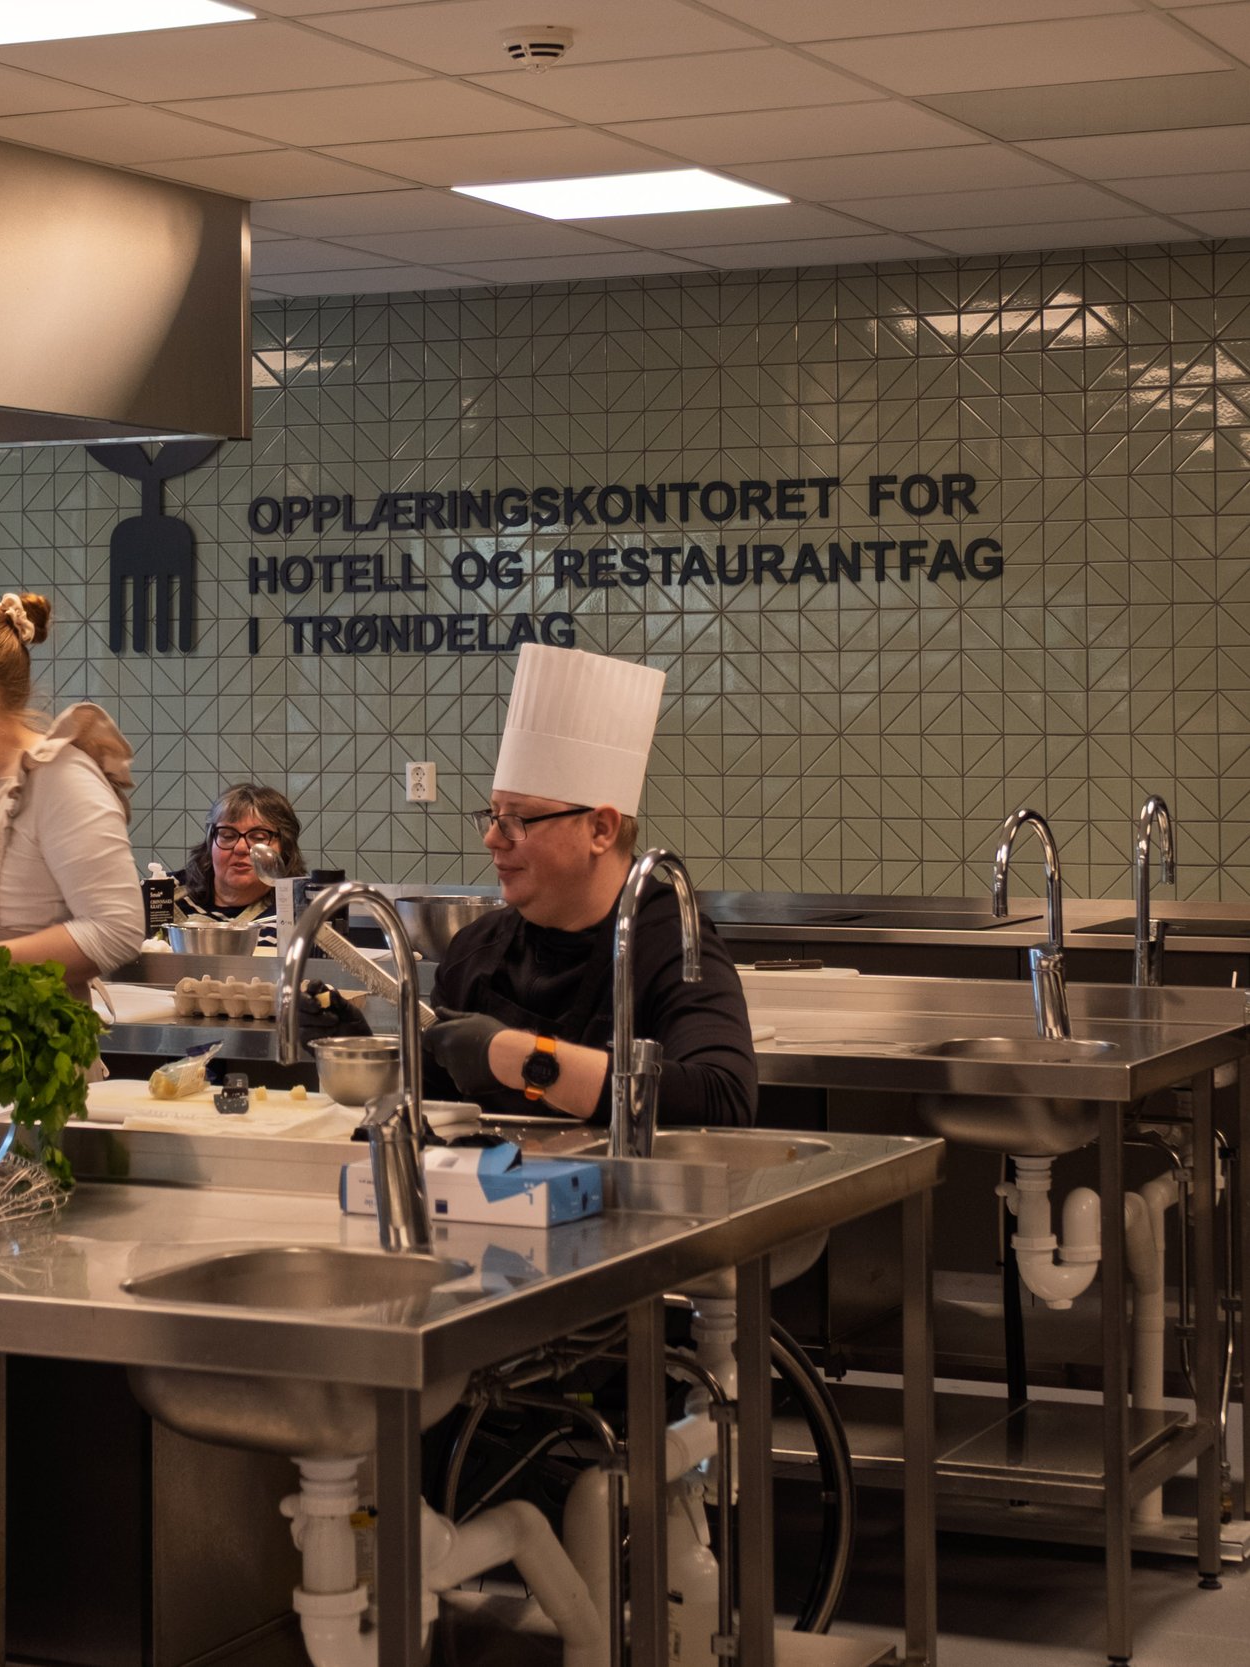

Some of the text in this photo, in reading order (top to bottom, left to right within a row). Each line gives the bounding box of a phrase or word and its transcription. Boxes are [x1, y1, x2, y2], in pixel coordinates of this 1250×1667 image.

[248, 473, 979, 534] OPPLÆRINGSKONTORET FOR
[248, 537, 1004, 594] HOTELL OG RESTAURANTFAG
[249, 612, 575, 655] I TRØNDELAG
